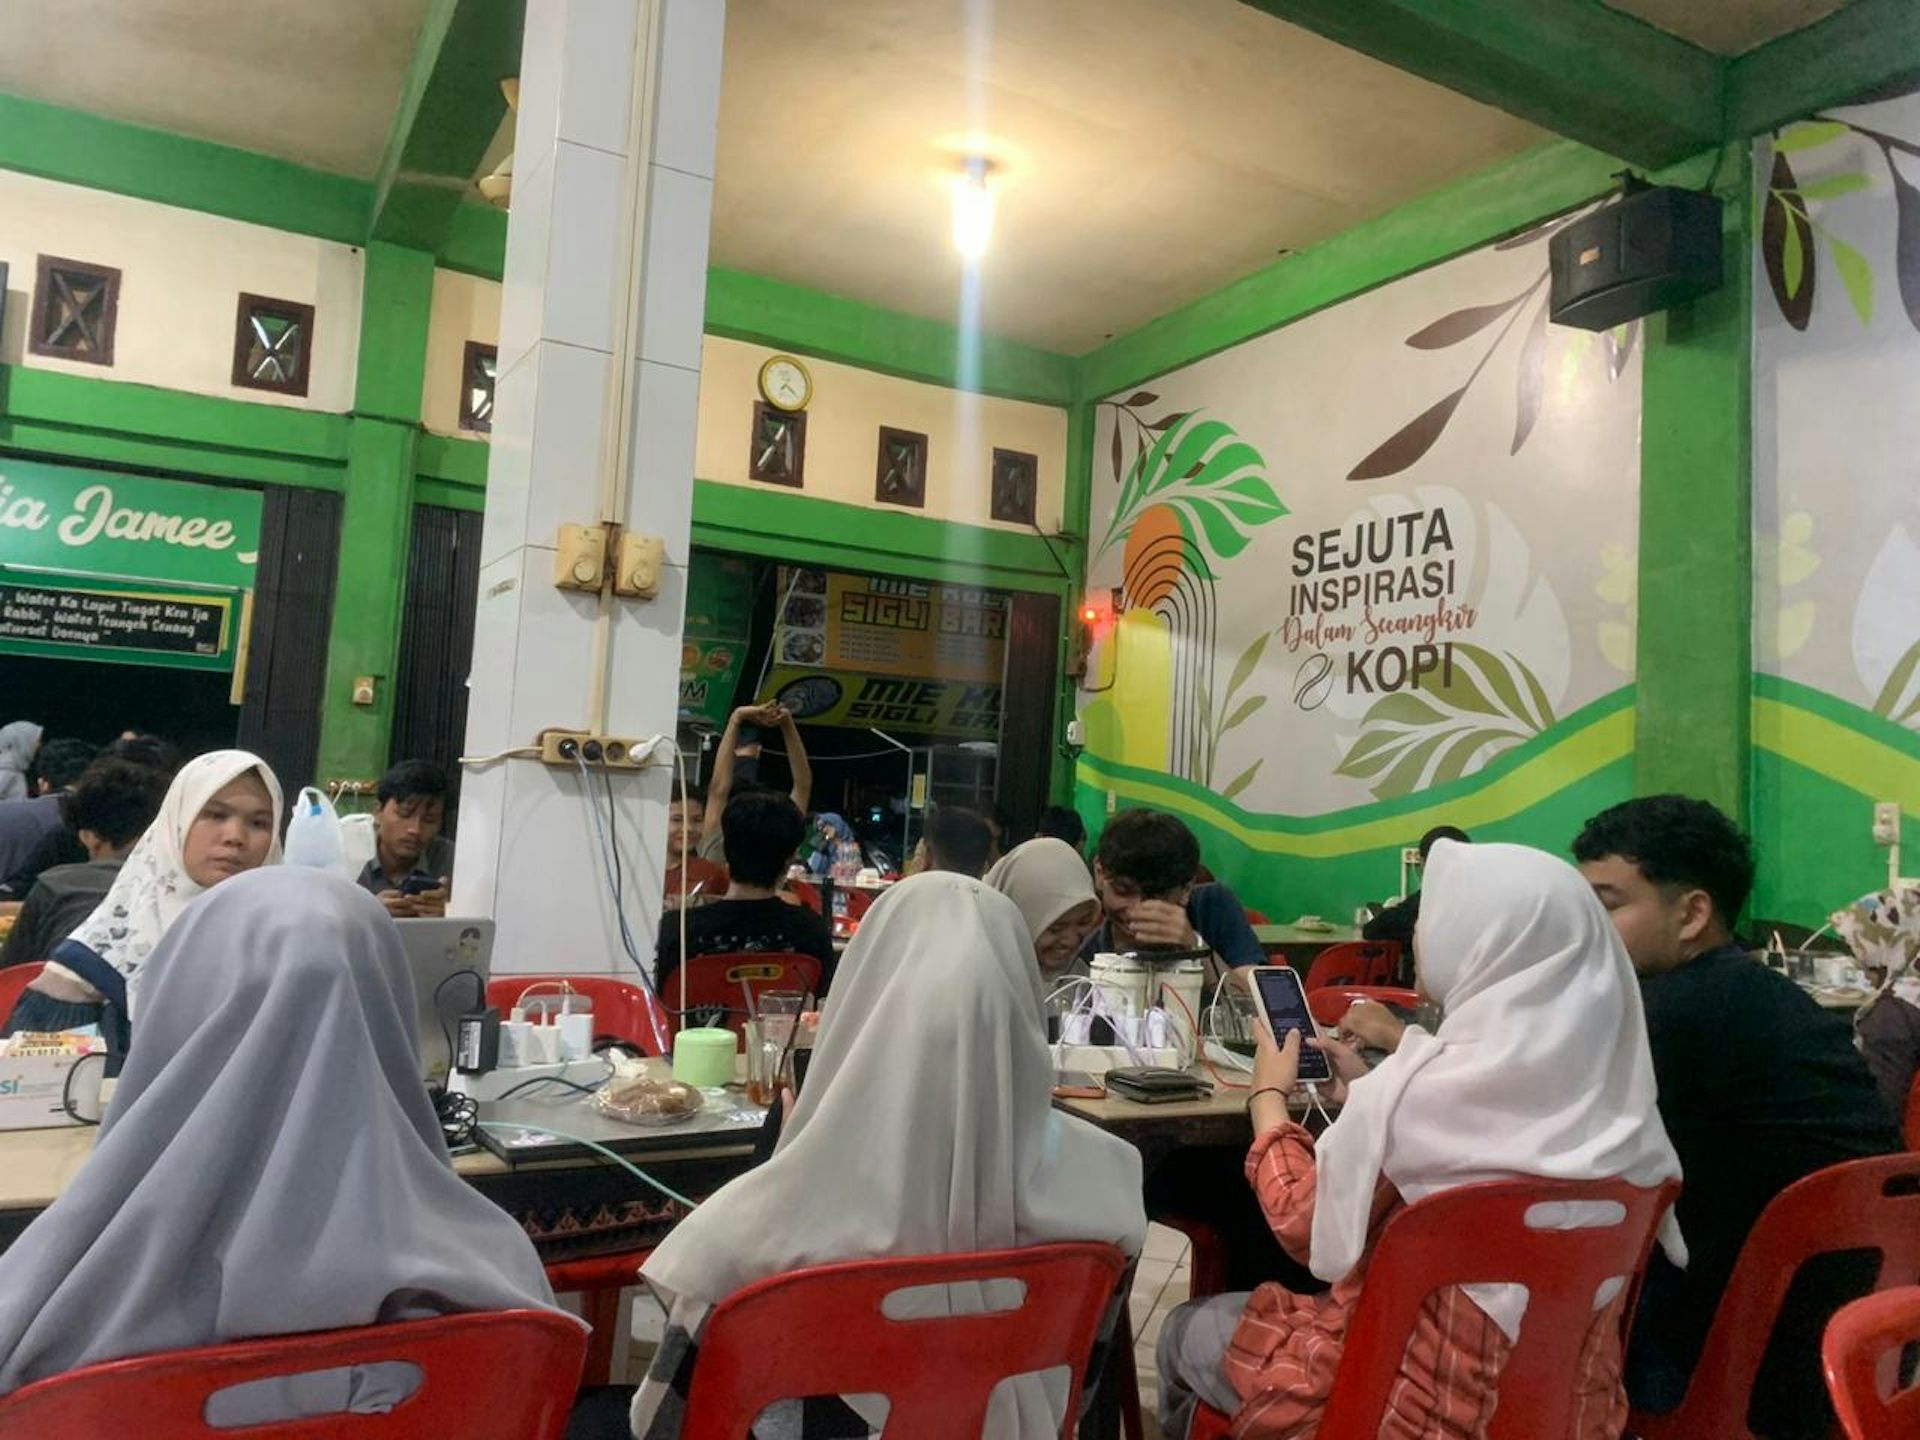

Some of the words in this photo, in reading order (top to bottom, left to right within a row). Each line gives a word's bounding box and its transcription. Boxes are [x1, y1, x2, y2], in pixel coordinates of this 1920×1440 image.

[58, 485, 236, 550] Jamee
[1291, 507, 1454, 577] SEJUTA
[1290, 559, 1455, 616] INSPIRASI
[841, 592, 930, 631] SIGLI
[1277, 612, 1355, 653] Dalam
[1347, 641, 1452, 694] KOPI
[847, 702, 940, 724] SIGLI
[857, 678, 948, 706] MIE
